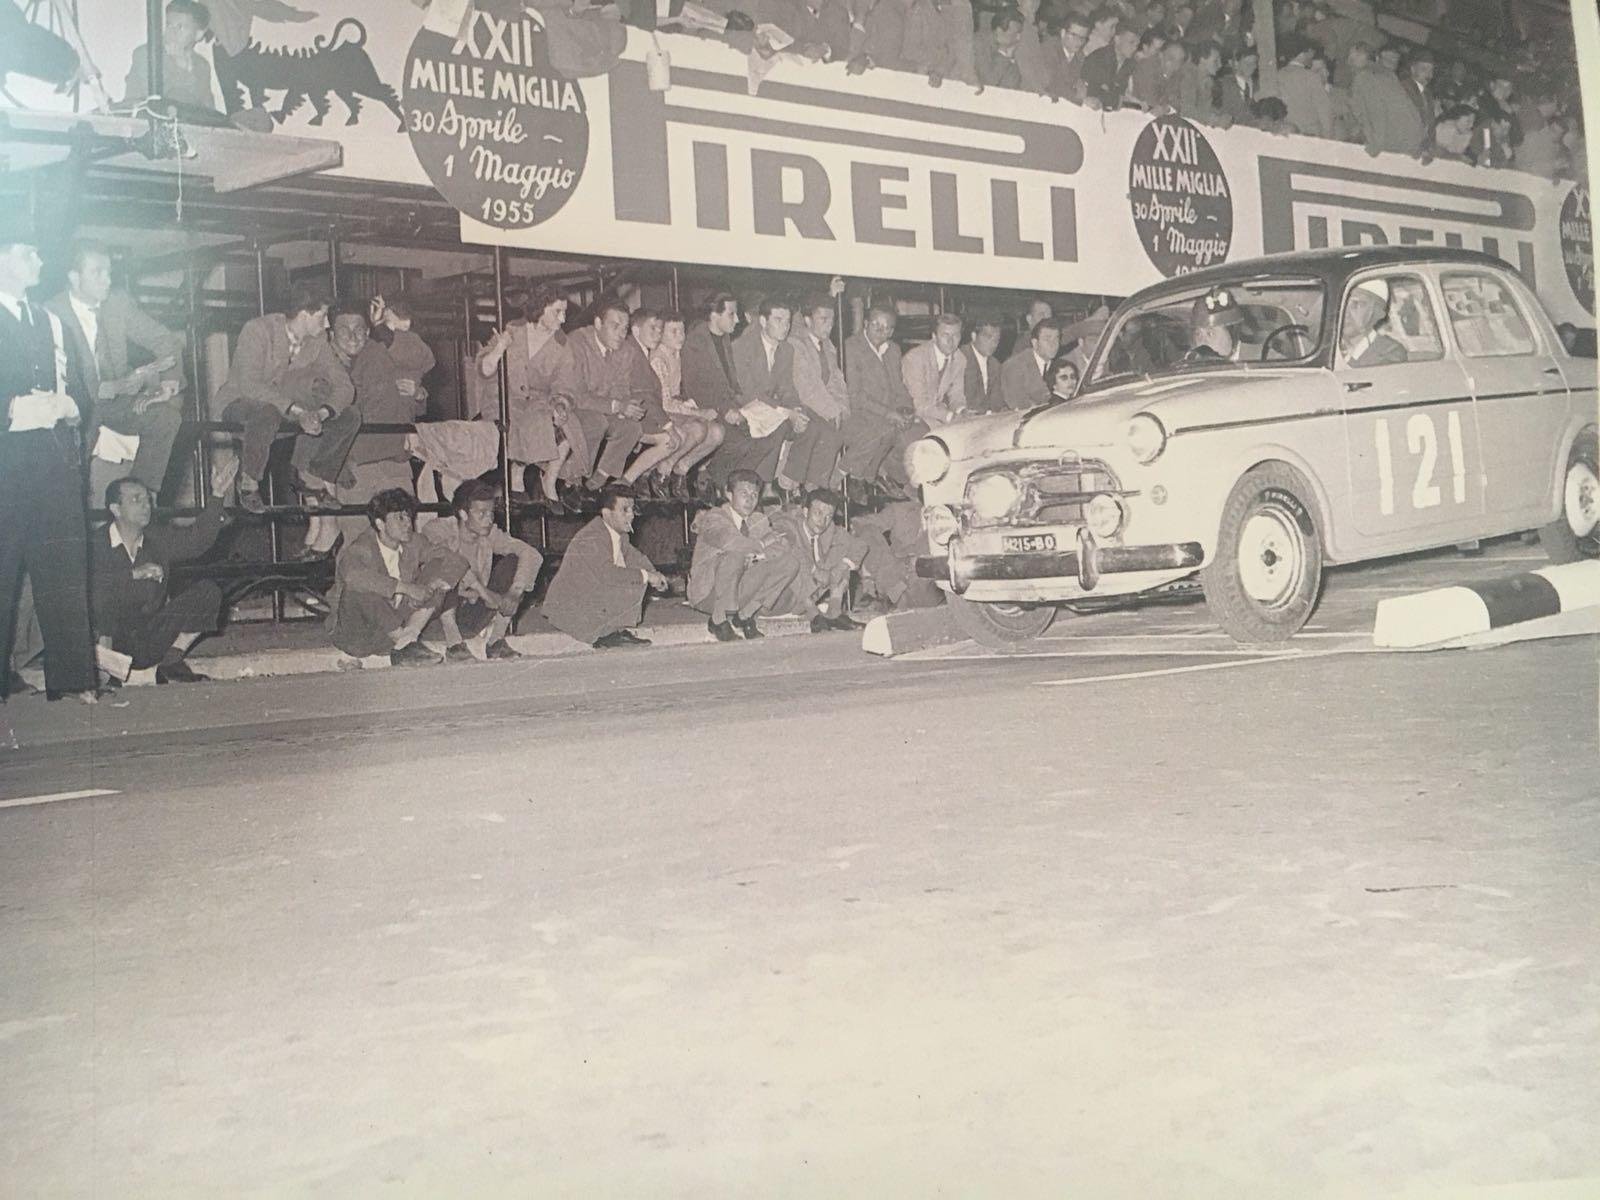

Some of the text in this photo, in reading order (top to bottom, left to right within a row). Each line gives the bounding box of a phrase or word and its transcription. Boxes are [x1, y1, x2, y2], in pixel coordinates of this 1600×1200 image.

[410, 58, 581, 114] MILLE MIGLIA
[411, 108, 435, 132] 30
[437, 98, 528, 150] Aprile
[443, 145, 576, 200] 1 Maggio
[608, 57, 1085, 264] PIRELLI
[1132, 163, 1228, 198] MILLE MIGLIA
[481, 197, 535, 224] 1955
[1134, 202, 1148, 220] 30
[1150, 193, 1199, 231] Aprile
[1152, 226, 1228, 266] 1 Maggio
[1374, 410, 1466, 516] 121
